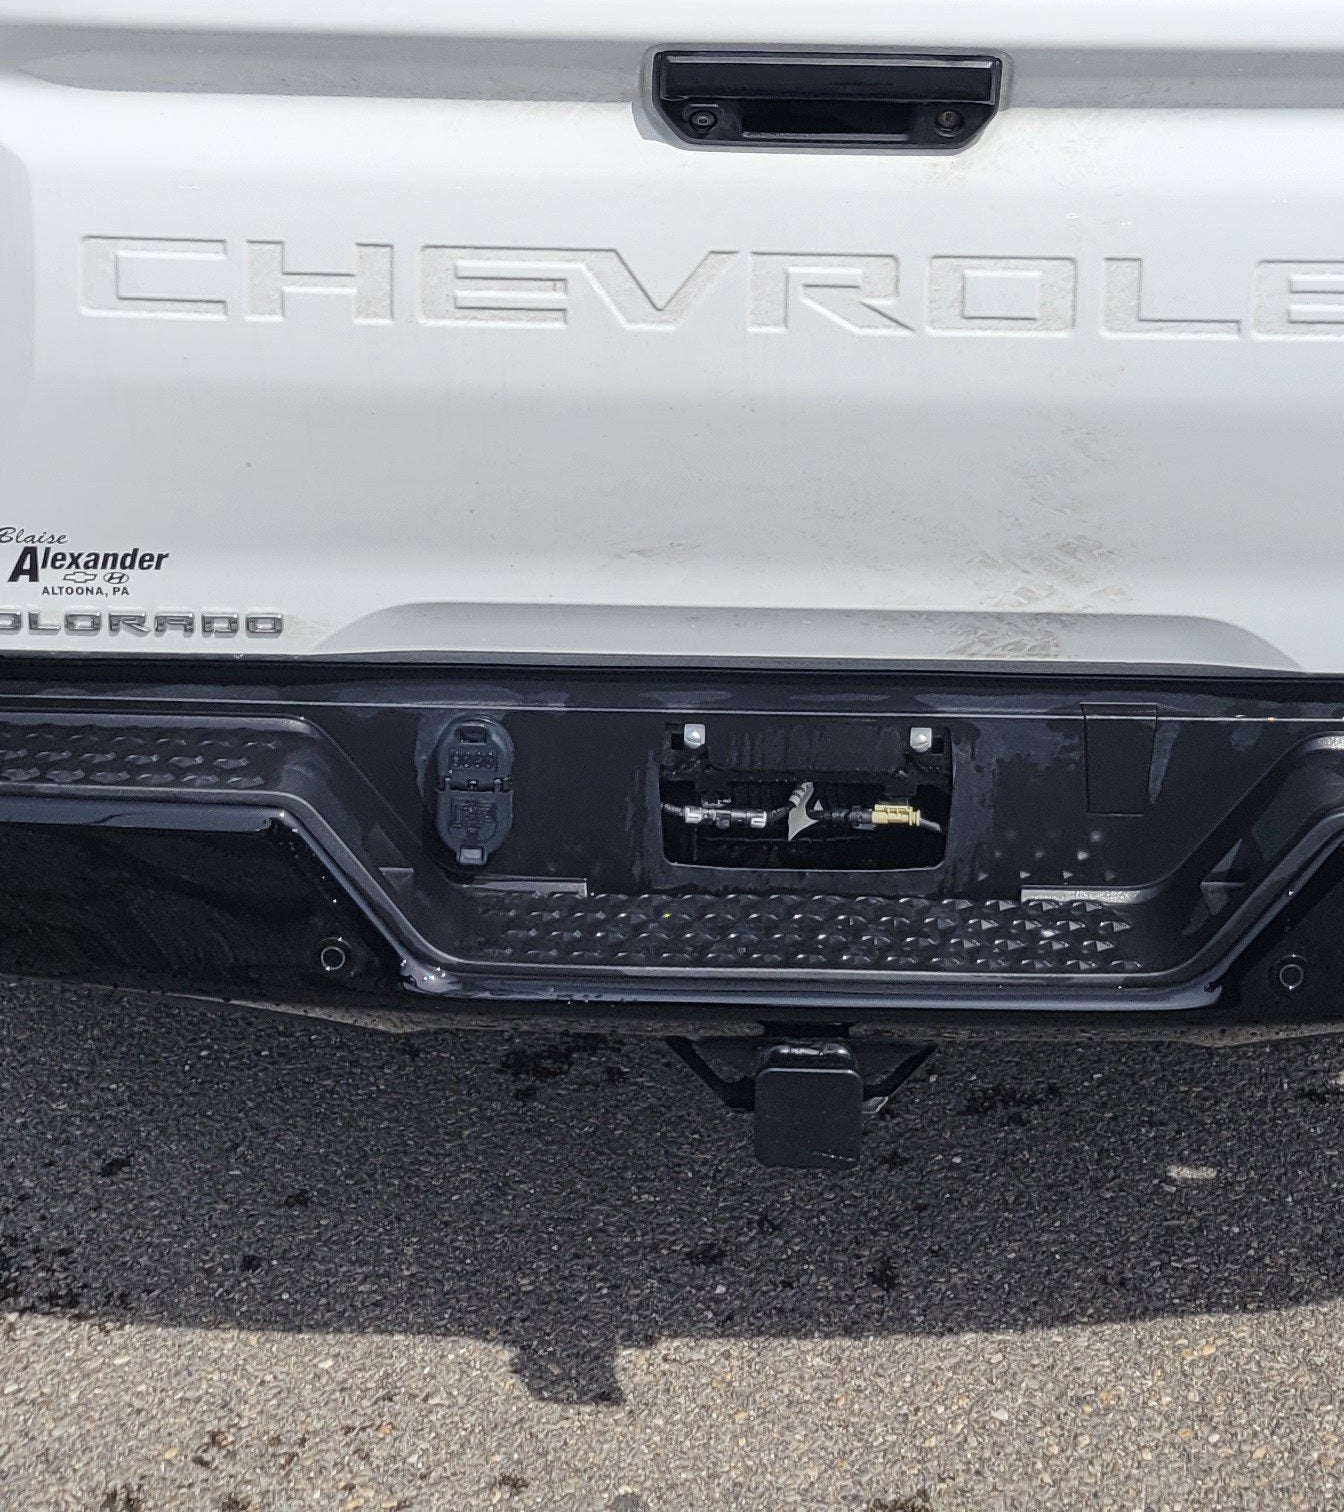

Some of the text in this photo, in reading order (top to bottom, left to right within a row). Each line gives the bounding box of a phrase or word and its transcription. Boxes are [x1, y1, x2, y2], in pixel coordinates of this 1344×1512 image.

[7, 545, 170, 583] Alexander
[41, 586, 129, 597] ALTOONA, PA
